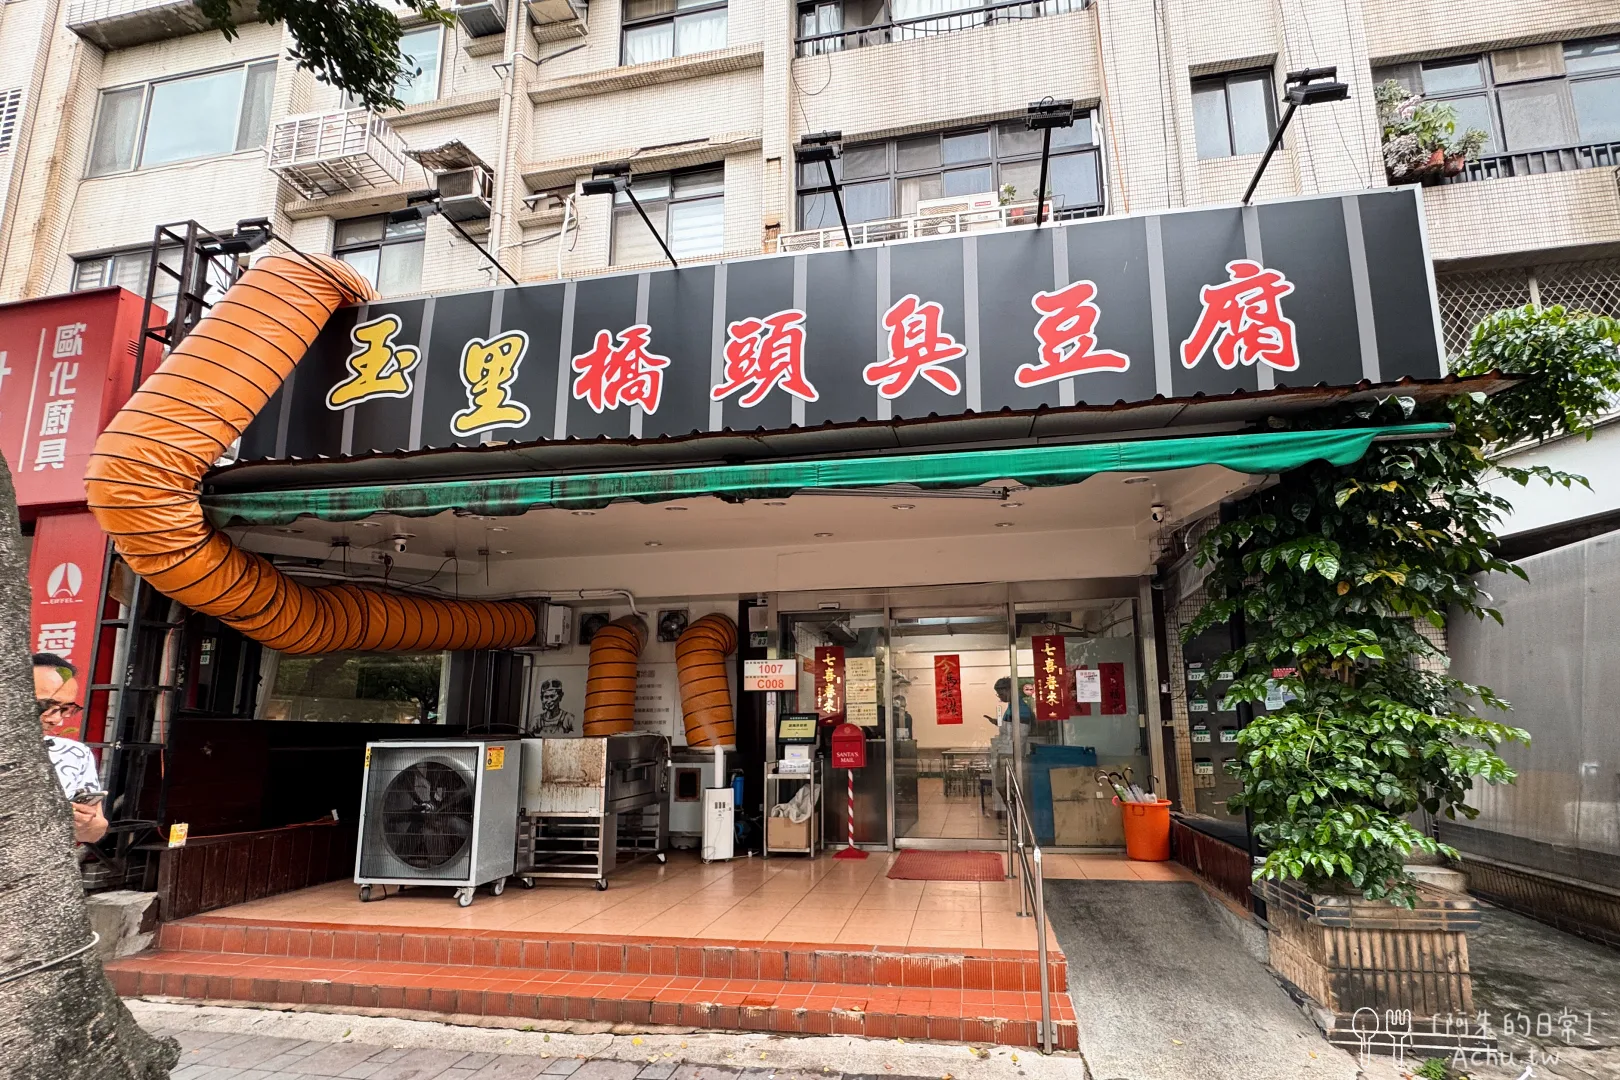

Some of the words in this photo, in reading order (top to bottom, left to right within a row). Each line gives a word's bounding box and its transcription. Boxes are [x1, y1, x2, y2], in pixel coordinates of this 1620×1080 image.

[326, 259, 1300, 438] 玉里橋頭臭豆腐
[34, 322, 87, 472] 歐化廚具
[757, 679, 784, 689] C008
[758, 664, 783, 674] 1007
[822, 653, 837, 714] 七喜春來
[1041, 643, 1060, 706] 七喜春來
